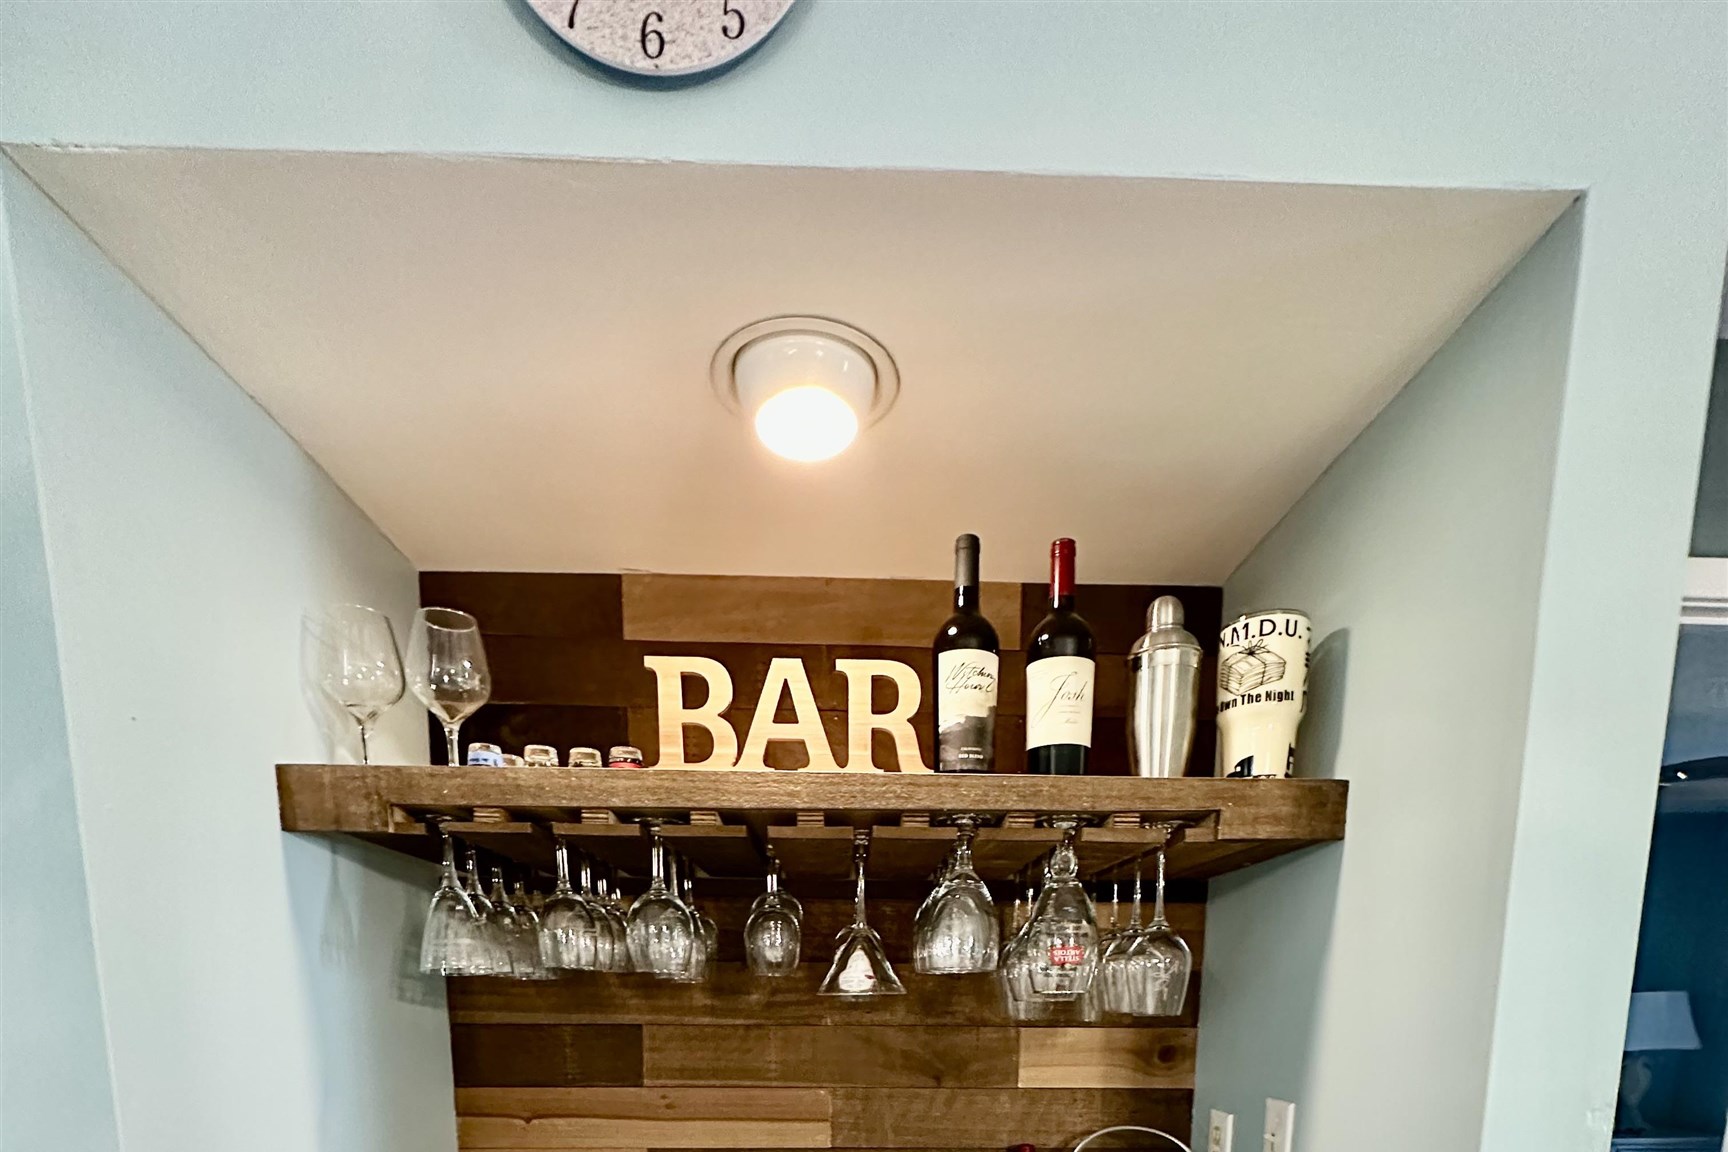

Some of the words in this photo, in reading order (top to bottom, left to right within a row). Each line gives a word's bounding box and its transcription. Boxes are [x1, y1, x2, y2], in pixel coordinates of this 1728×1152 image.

[640, 11, 665, 59] 6
[721, 0, 745, 39] 5
[643, 655, 935, 772] BAR
[1031, 671, 1088, 728] Josh
[1241, 693, 1262, 705] The
